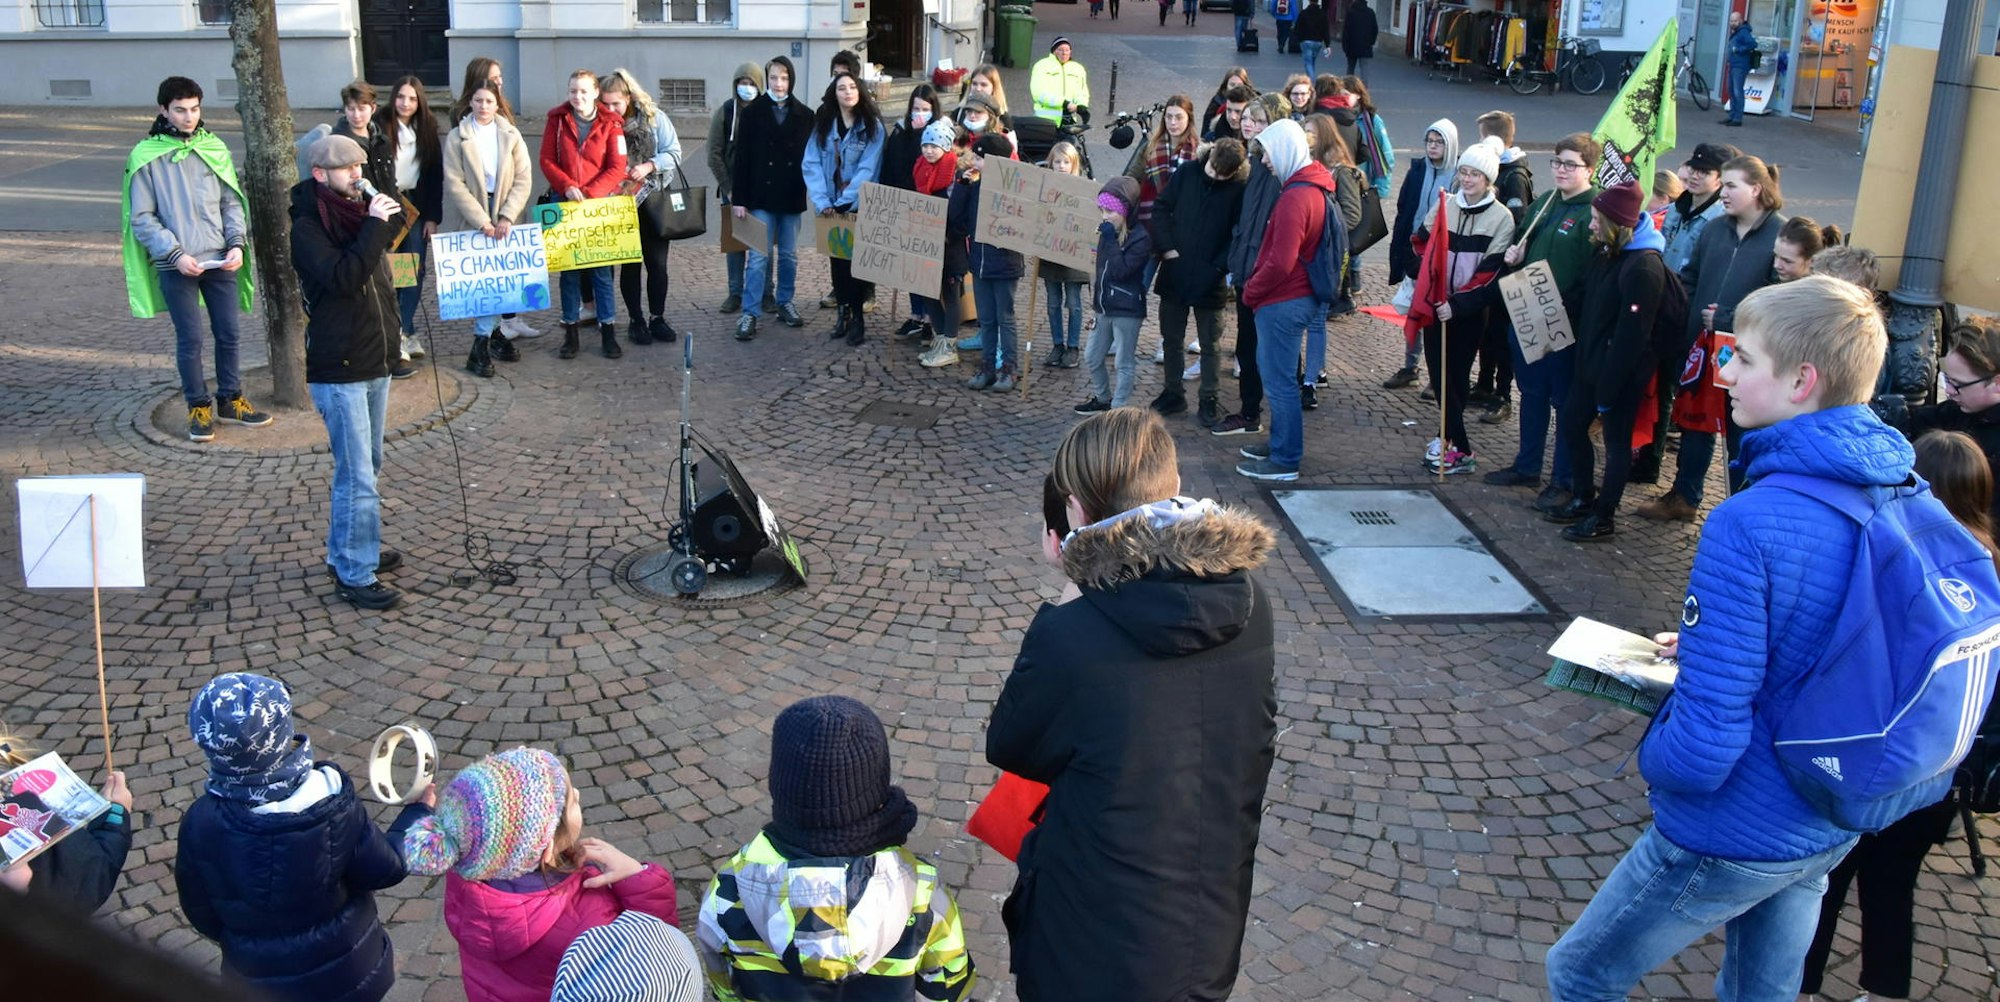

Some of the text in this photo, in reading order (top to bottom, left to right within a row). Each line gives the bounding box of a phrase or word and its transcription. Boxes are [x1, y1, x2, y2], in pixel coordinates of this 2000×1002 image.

[1745, 86, 1763, 97] dm
[997, 160, 1027, 192] Wir
[541, 206, 579, 226] Der
[865, 205, 900, 226] NICHT
[991, 192, 1025, 218] Nicht
[435, 227, 539, 253] THE CLIMATE
[544, 222, 635, 240] Artenschutz
[564, 239, 581, 250] und
[586, 237, 617, 248] bleibt
[437, 259, 456, 277] IS
[461, 248, 544, 276] CHANGING
[859, 248, 897, 273] NICHT
[465, 296, 503, 315] WE?
[1525, 266, 1567, 341] STOPPEN
[1506, 287, 1539, 349] KOHLE
[1957, 645, 1970, 655] FC
[1811, 757, 1844, 782] adidas
